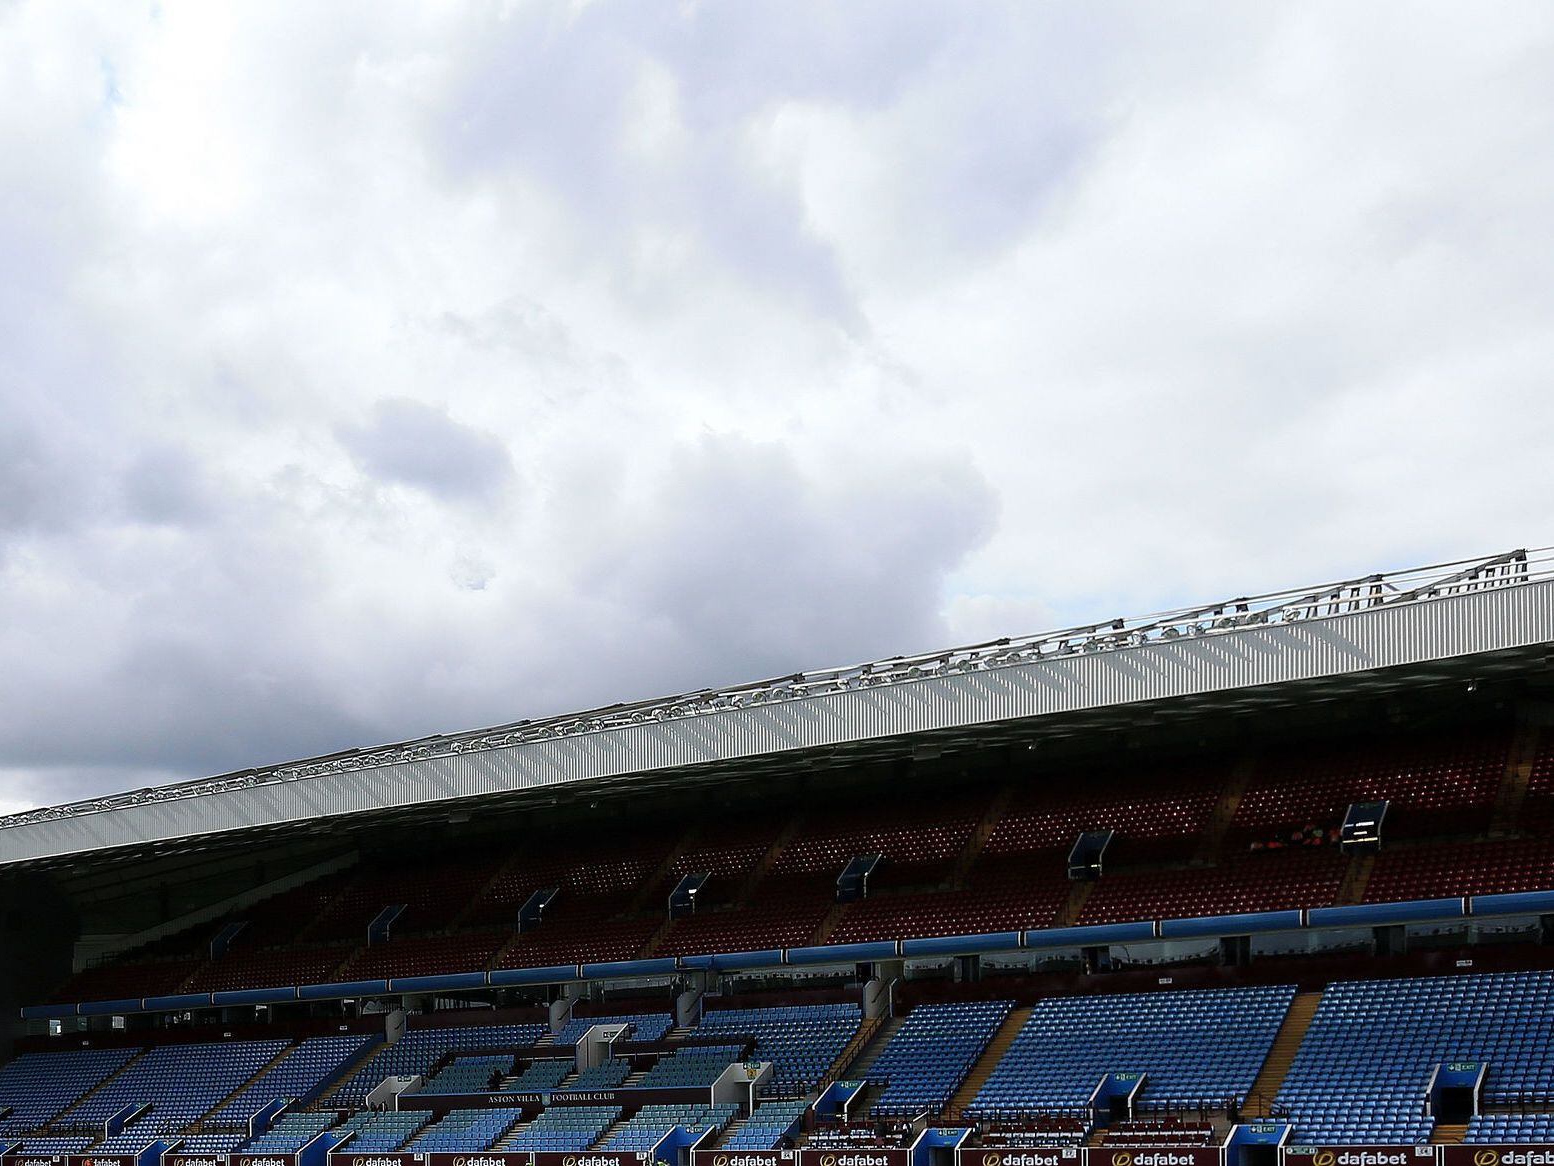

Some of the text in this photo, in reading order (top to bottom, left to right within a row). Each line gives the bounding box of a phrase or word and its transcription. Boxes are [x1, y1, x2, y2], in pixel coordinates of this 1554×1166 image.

[488, 1092, 615, 1104] ASTON VILLA FOOTBALL CLUB
[837, 1155, 889, 1166] dafabet
[1002, 1154, 1059, 1166] dafabet
[1133, 1152, 1195, 1166] dafabet
[1337, 1152, 1407, 1166] dafabet
